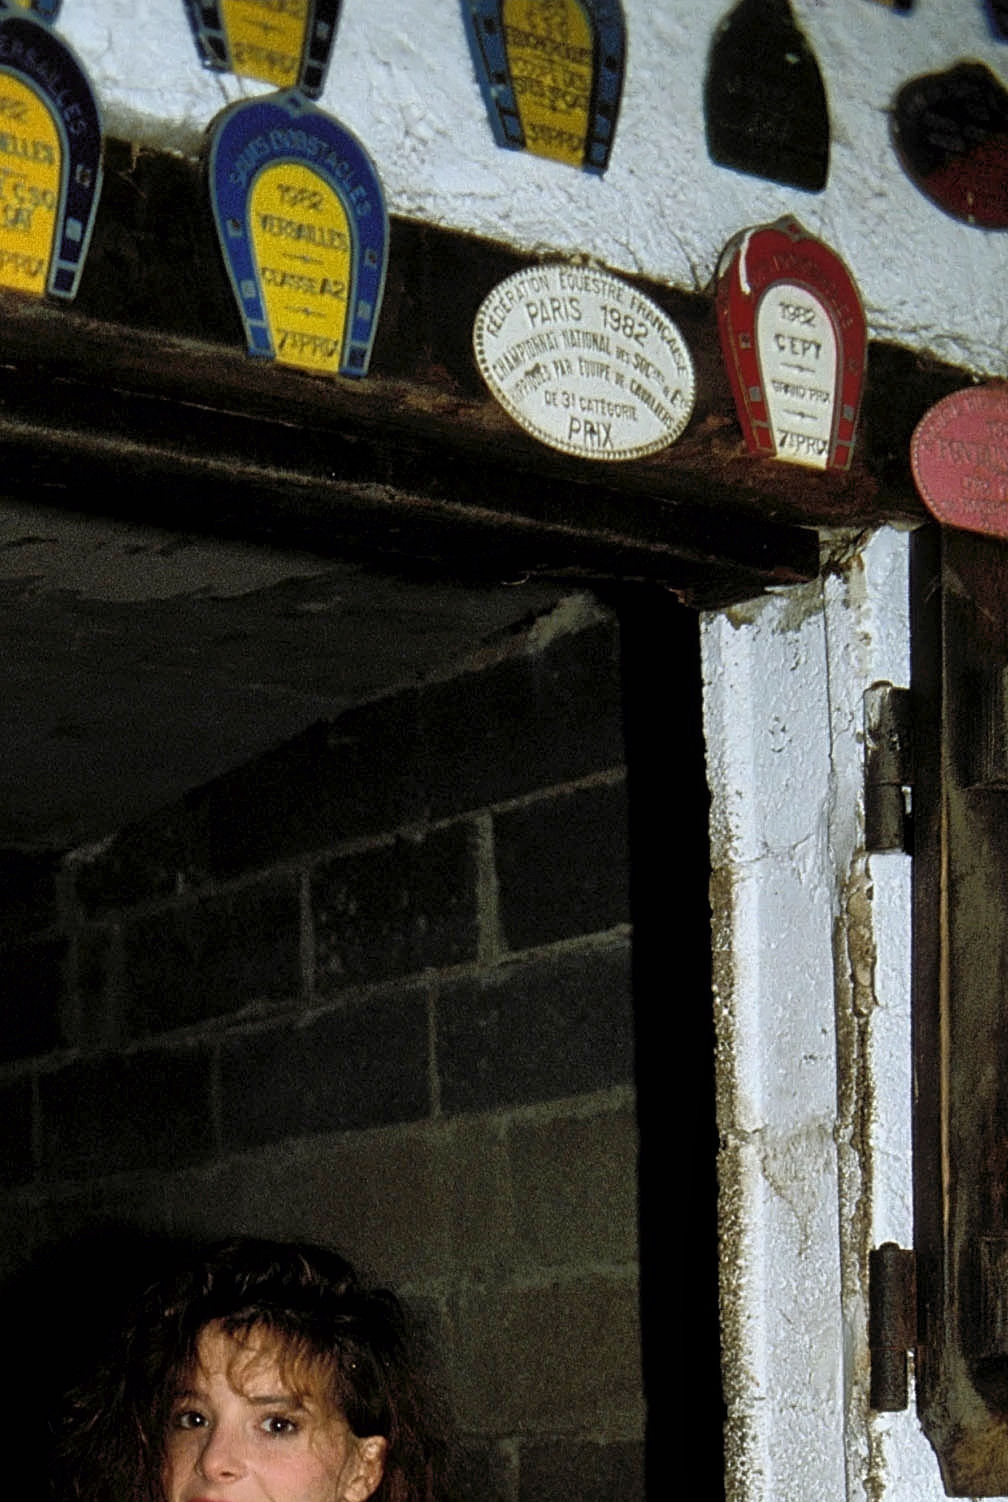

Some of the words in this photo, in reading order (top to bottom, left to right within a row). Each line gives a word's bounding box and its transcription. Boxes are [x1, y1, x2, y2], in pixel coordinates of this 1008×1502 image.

[258, 212, 349, 252] VERSAILLES
[526, 298, 582, 329] PARIS
[600, 304, 650, 347] 1982
[778, 301, 816, 328] 1982
[492, 332, 560, 383] CHAMPIONNAT
[563, 329, 612, 355] NATIONAL
[544, 389, 558, 407] DE
[553, 358, 573, 378] PAR
[614, 371, 626, 388] DE
[629, 378, 676, 430] CAVALIERS
[568, 415, 614, 449] PRIX
